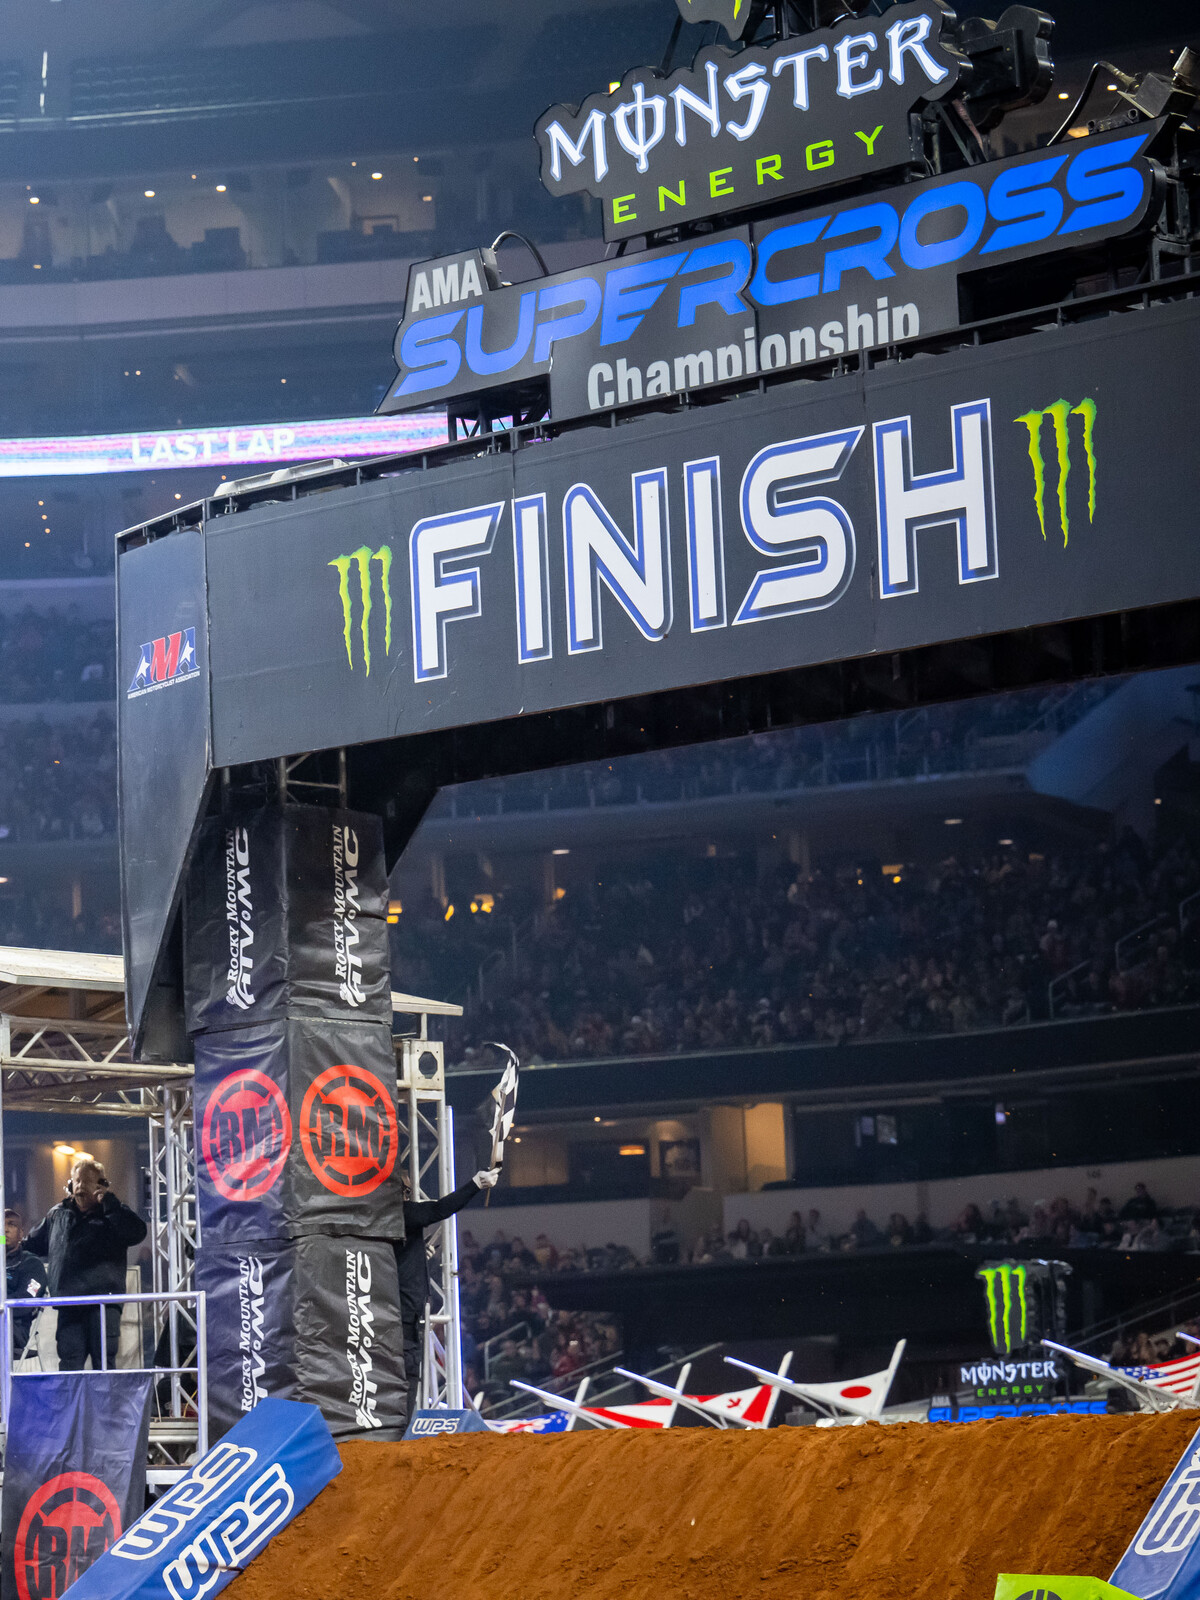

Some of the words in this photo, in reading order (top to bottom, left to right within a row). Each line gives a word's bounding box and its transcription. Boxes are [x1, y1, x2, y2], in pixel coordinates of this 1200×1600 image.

[545, 13, 949, 183] MONSTER
[612, 125, 886, 225] ENERGY
[393, 133, 1151, 398] SUPERCROSS
[410, 255, 484, 312] AMA
[586, 296, 921, 411] Championship
[131, 433, 218, 464] LAST
[228, 428, 296, 457] LAP
[408, 397, 1001, 684] FINISH
[127, 626, 200, 693] AMA
[226, 828, 238, 924] MOUNTAIN
[332, 825, 345, 920] MOUNTAIN
[227, 925, 239, 982] ROCKY
[333, 919, 346, 980] ROCKY
[238, 1256, 251, 1353] MOUNTAIN
[346, 1249, 360, 1349] MOUNTAIN
[241, 1355, 253, 1412] ROCKY
[346, 1349, 363, 1406] ROCKY
[961, 1360, 1058, 1386] MONSTER
[977, 1385, 1044, 1397] ENERGY
[411, 1417, 460, 1435] WPS
[110, 1442, 258, 1560] WPS
[162, 1462, 295, 1600] WPS
